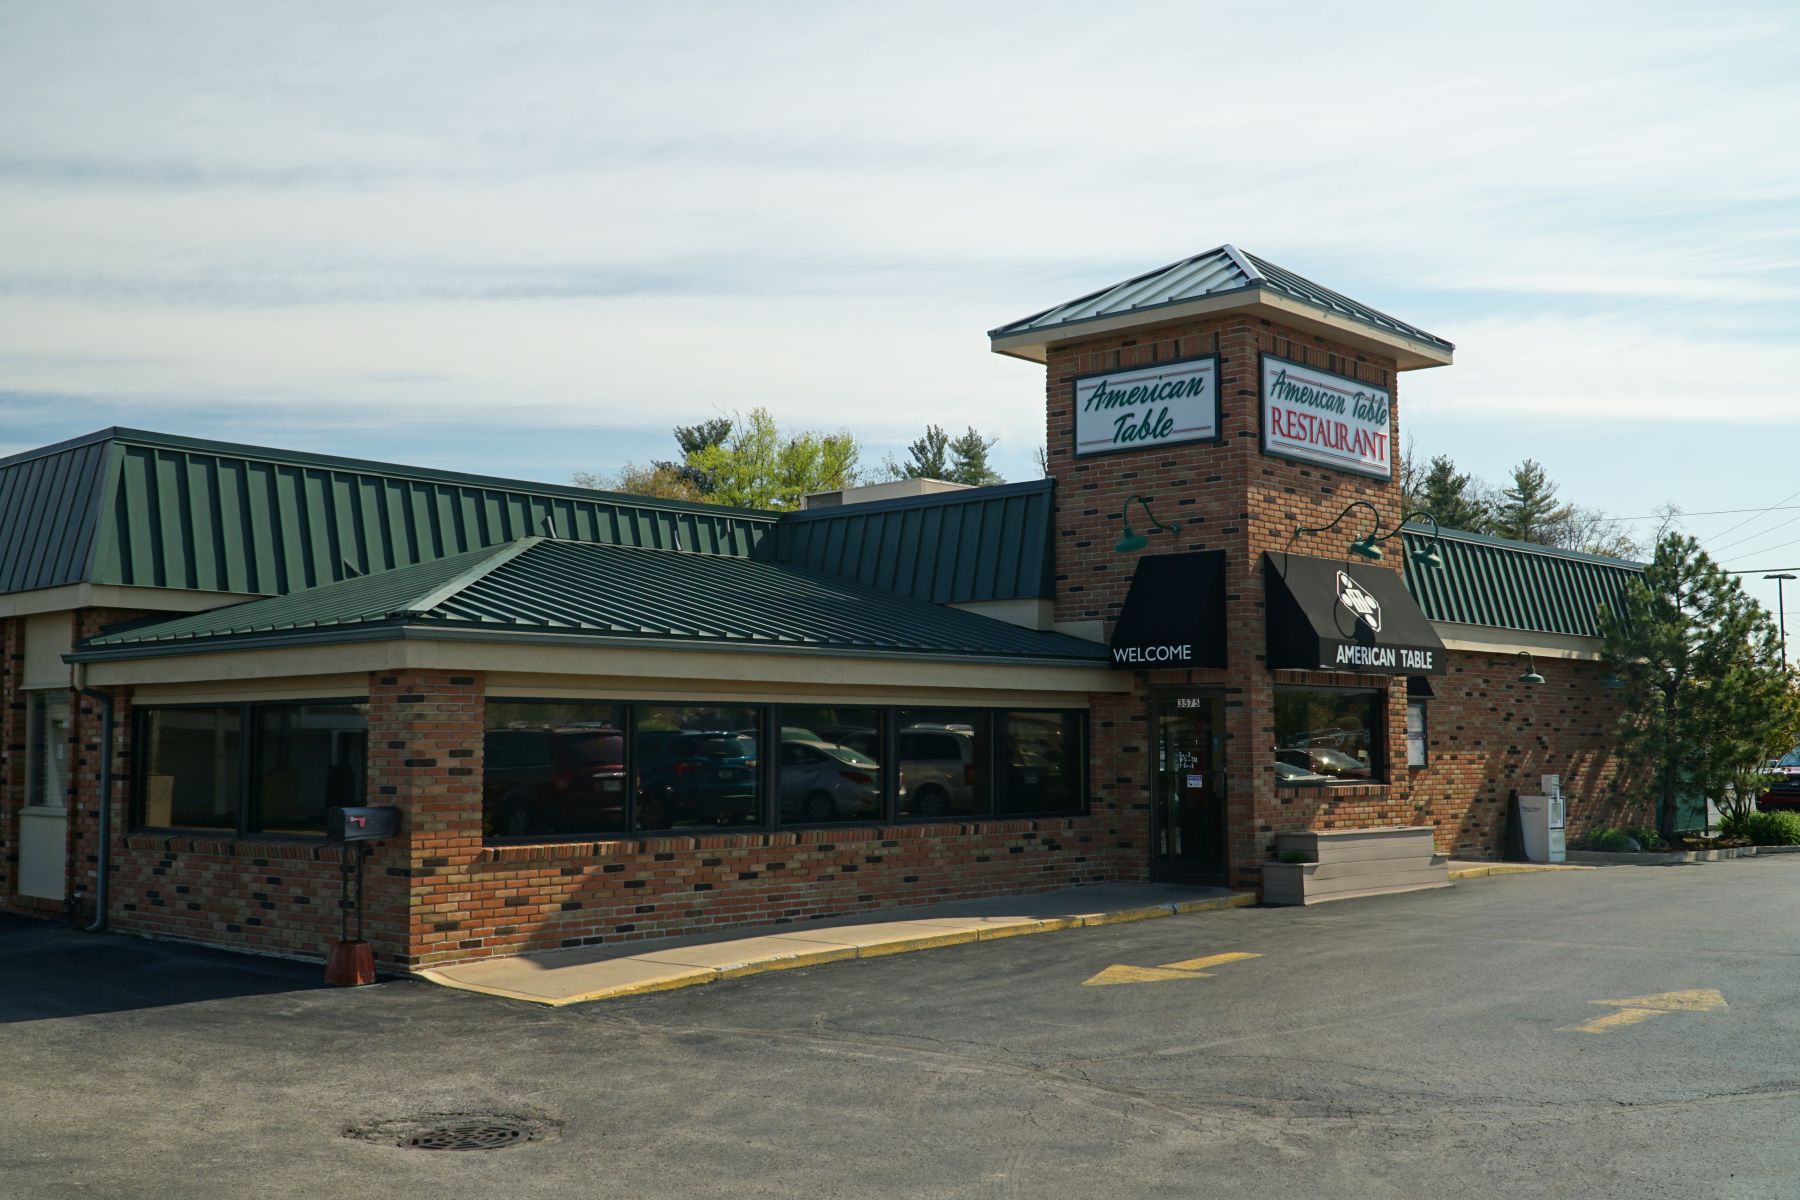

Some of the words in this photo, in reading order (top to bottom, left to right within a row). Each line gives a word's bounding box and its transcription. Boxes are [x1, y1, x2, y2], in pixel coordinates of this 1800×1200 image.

[1084, 375, 1205, 412] American
[1270, 369, 1346, 414] American
[1352, 391, 1387, 426] Table
[1113, 406, 1174, 443] Table
[1271, 406, 1387, 461] RESTAURANT
[1113, 644, 1192, 663] WELCOME
[1336, 645, 1396, 667] AMERICAN
[1400, 649, 1433, 669] TABLE
[1178, 699, 1200, 707] 3575
